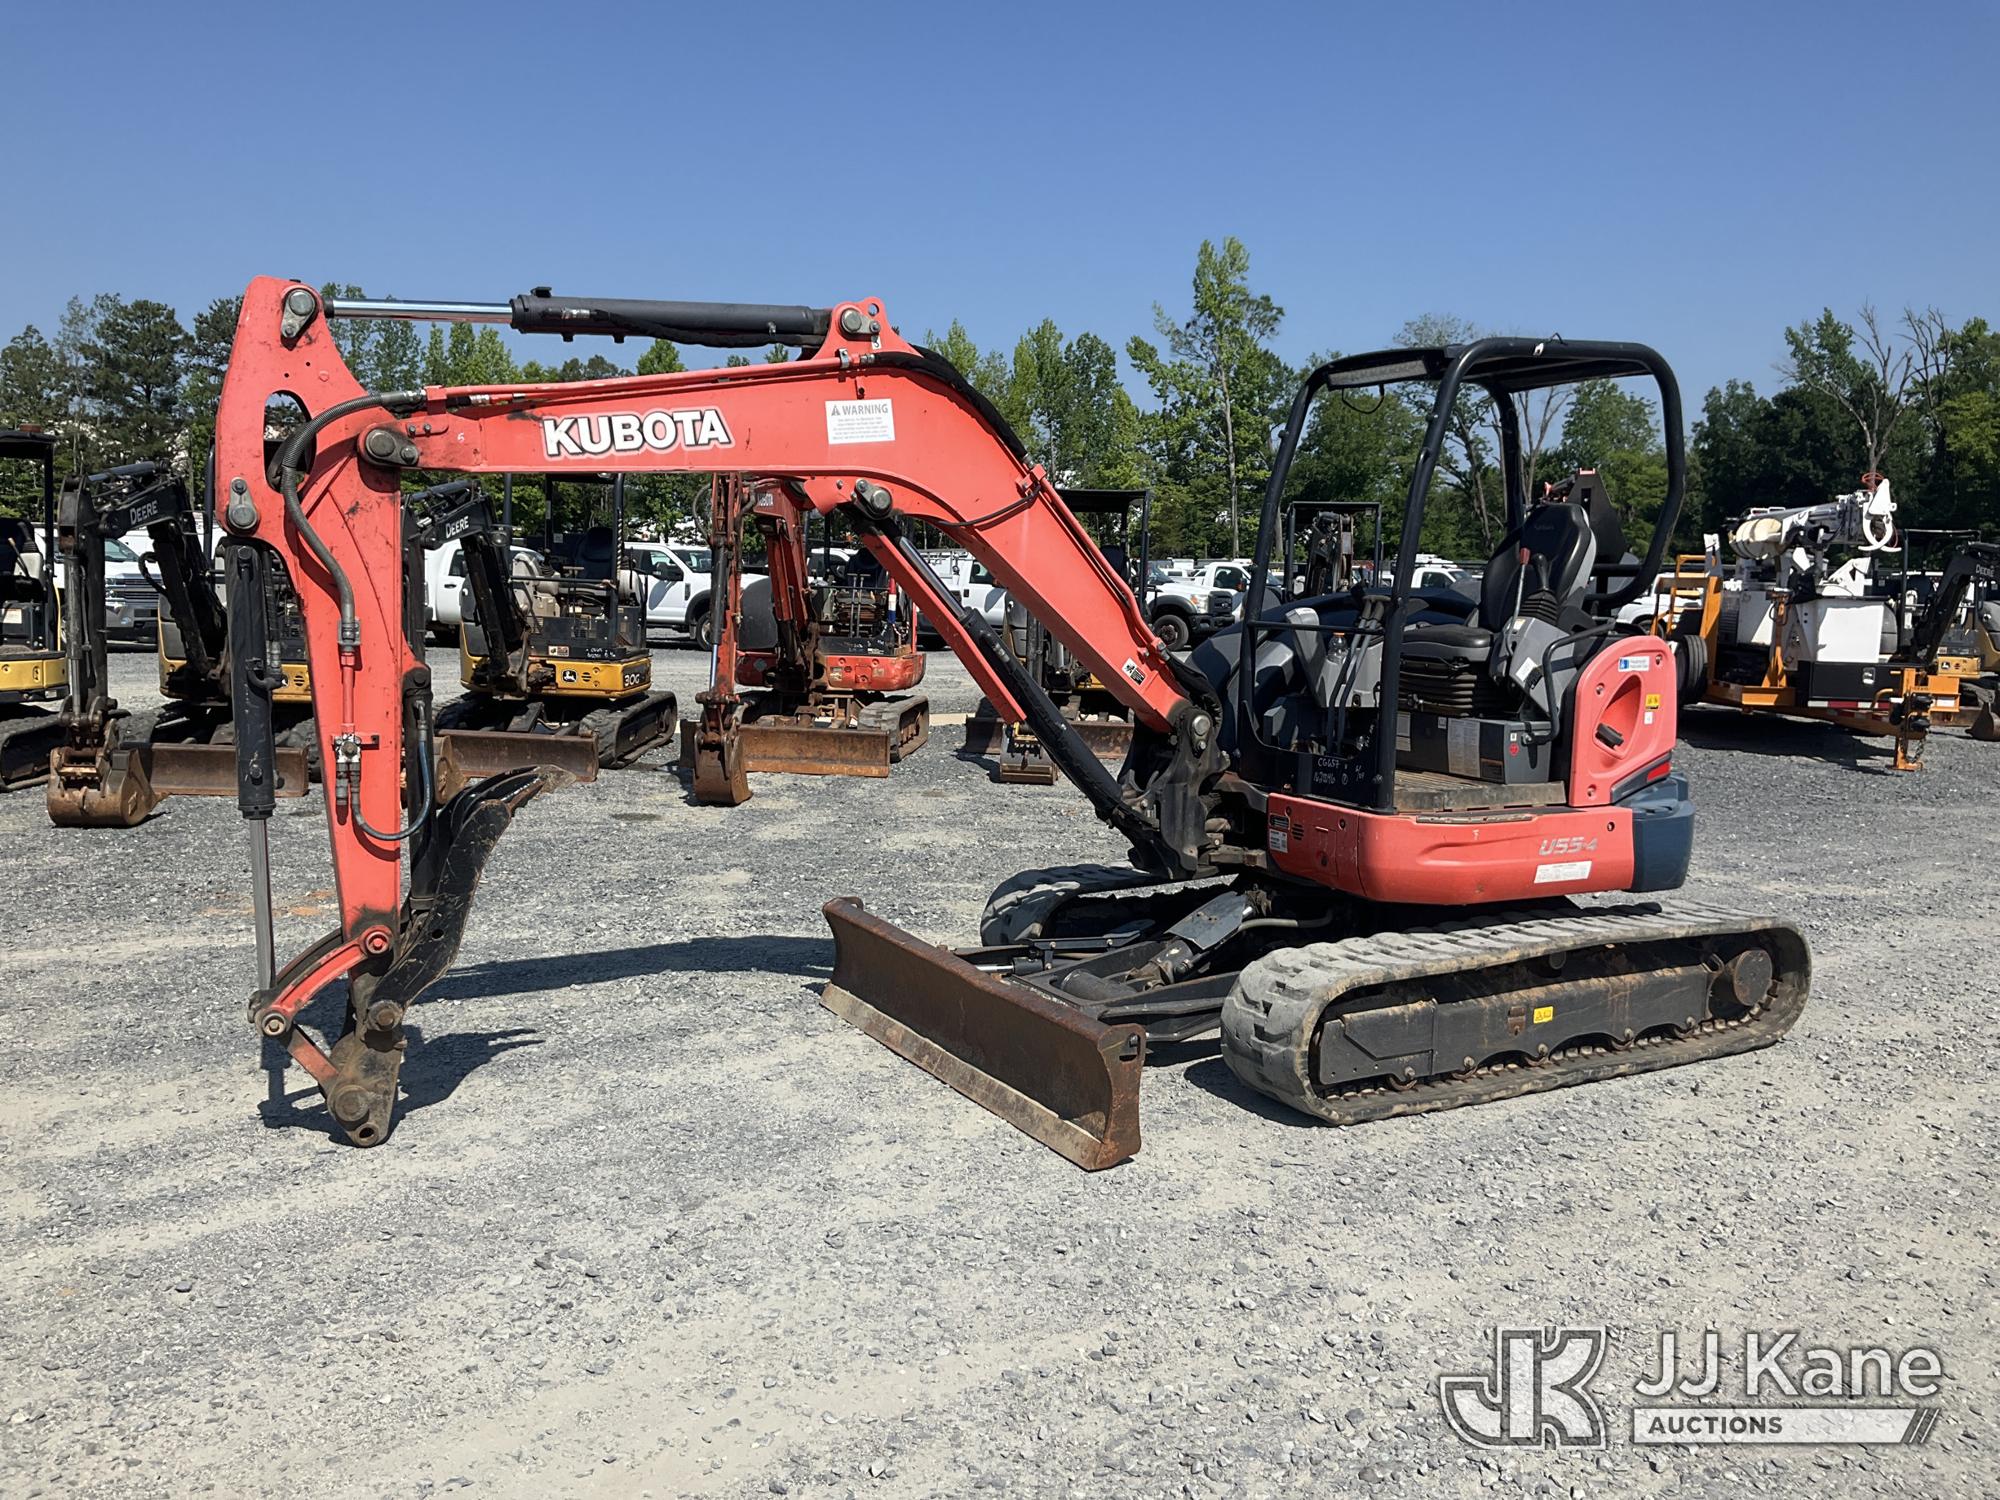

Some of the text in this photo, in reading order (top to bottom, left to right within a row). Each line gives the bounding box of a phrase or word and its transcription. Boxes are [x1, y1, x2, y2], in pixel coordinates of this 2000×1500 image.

[842, 403, 889, 416] WARNING
[542, 408, 732, 457] KUBOTA
[129, 500, 159, 525] DEERE
[445, 515, 469, 539] DEERE
[623, 673, 640, 687] 30G
[1538, 836, 1598, 856] U55-4
